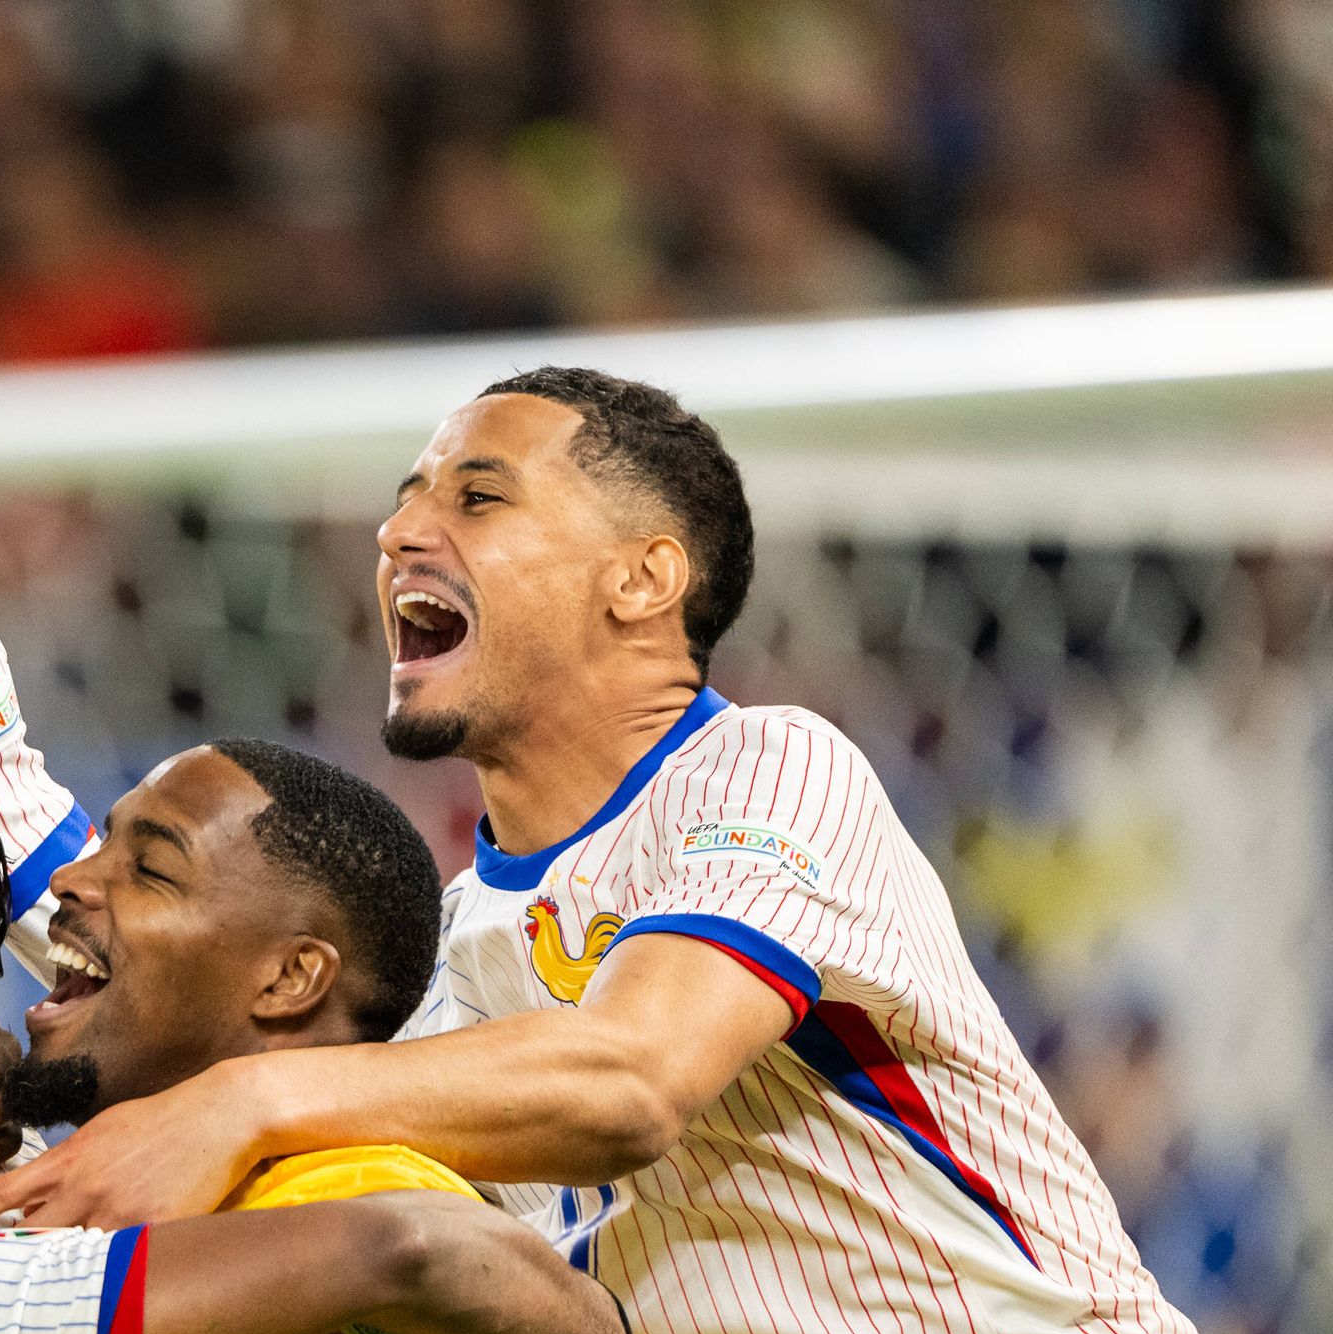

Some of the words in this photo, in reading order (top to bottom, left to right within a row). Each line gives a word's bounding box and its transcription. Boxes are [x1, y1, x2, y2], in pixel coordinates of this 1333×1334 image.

[687, 822, 720, 835] UEFA
[683, 831, 821, 882] FOUNDATION
[779, 860, 791, 870] for
[792, 870, 817, 890] children
